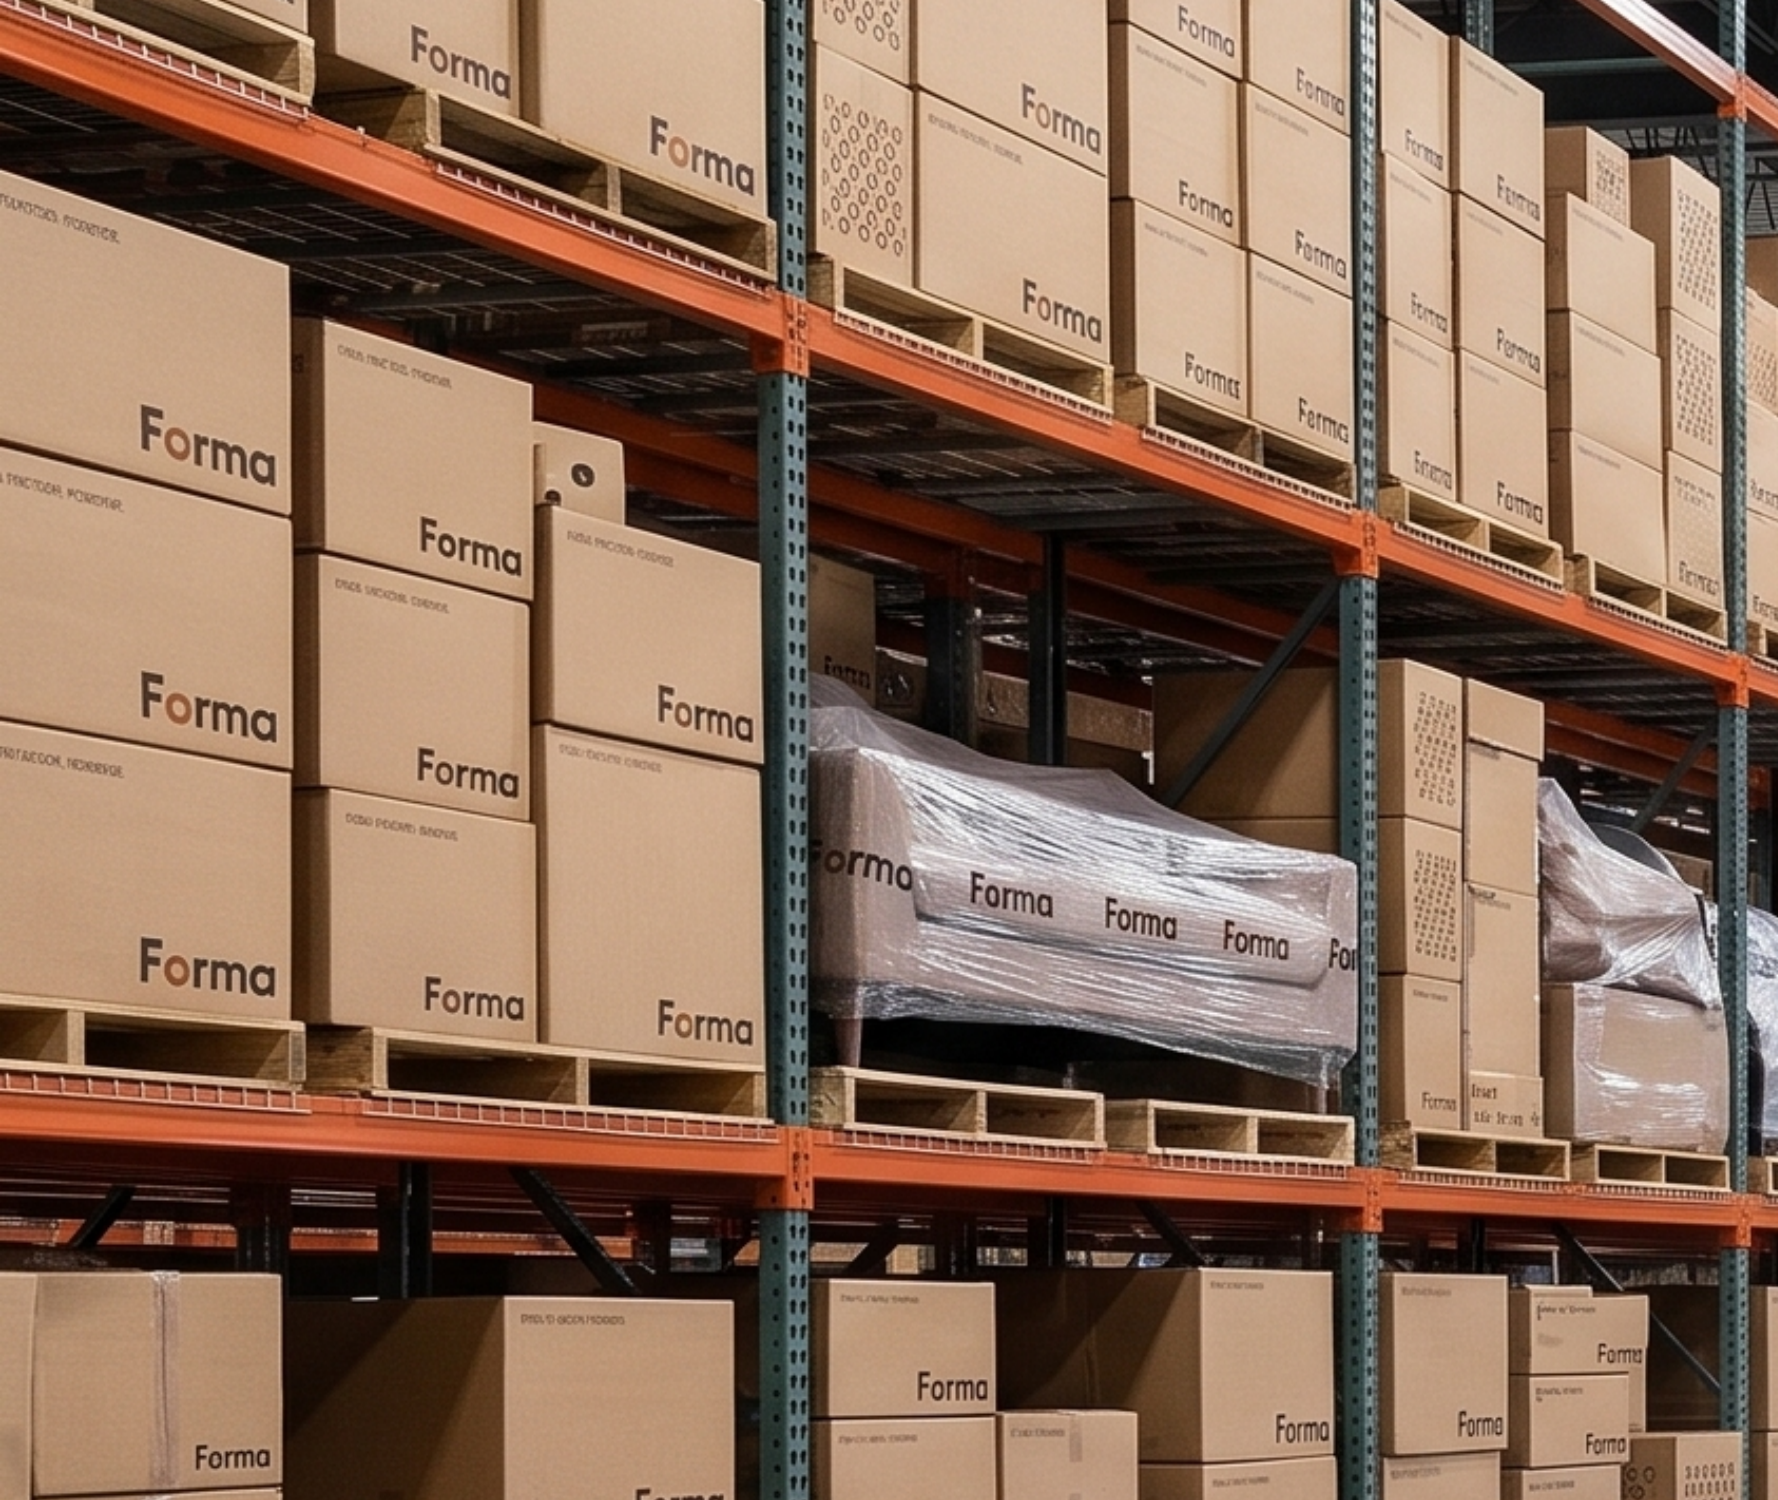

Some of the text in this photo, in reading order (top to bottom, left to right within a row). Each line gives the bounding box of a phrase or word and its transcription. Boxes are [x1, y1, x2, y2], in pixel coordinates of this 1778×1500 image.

[1178, 5, 1234, 57] Forma
[411, 25, 511, 99] Forma
[1021, 83, 1101, 155] Forma
[650, 115, 754, 195] Forma
[1022, 279, 1101, 343] Forma
[140, 404, 276, 486] Forma
[419, 517, 521, 576] Forma
[141, 671, 277, 742] Forma
[658, 685, 753, 742] Forma
[417, 748, 519, 799] Forma
[970, 871, 1289, 961] Forma Forma Forma
[140, 937, 276, 997] Forma
[424, 976, 524, 1021] Forma
[658, 1000, 753, 1046] Forma
[918, 1372, 988, 1401] Forma
[196, 1444, 271, 1470] Forma
[1276, 1413, 1330, 1444] Forma
